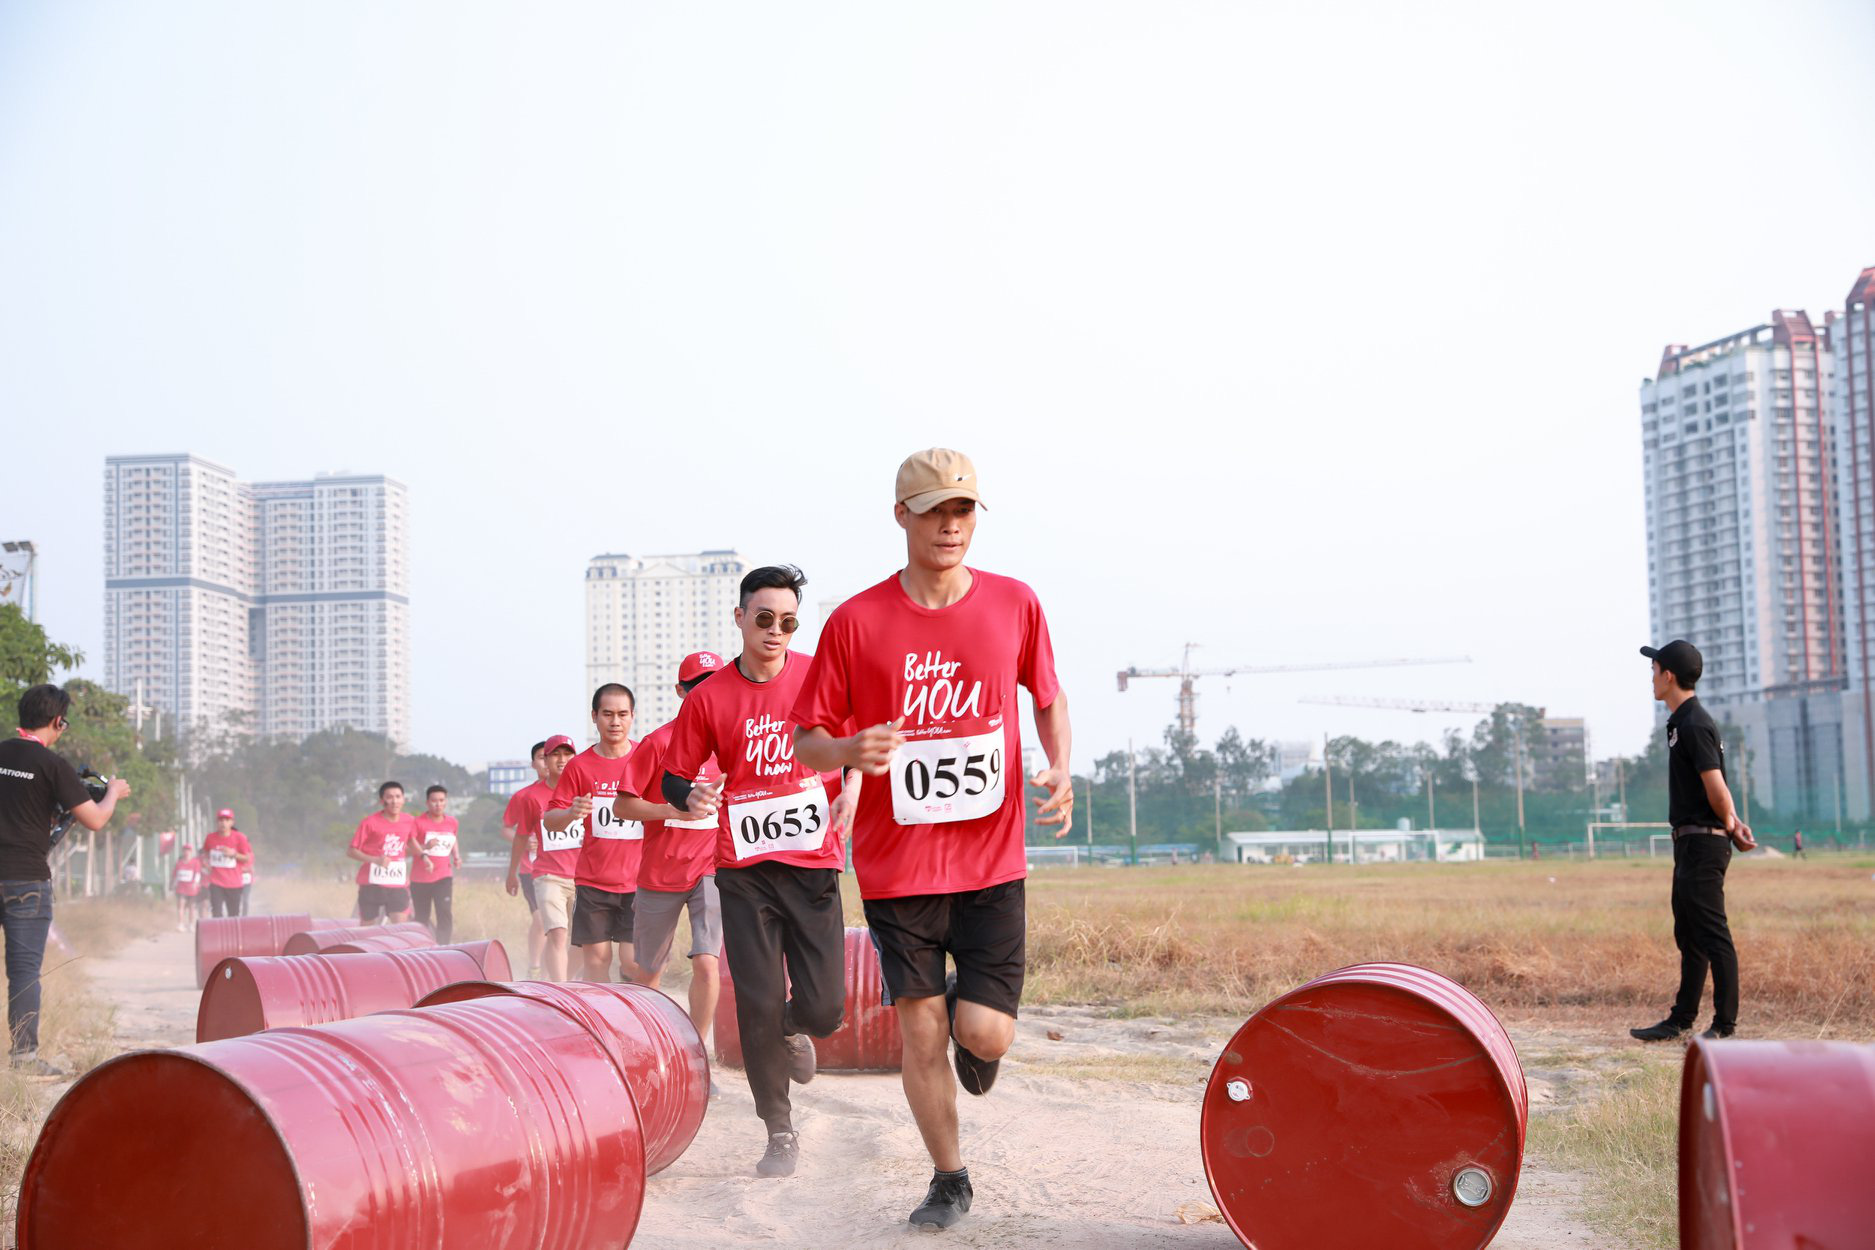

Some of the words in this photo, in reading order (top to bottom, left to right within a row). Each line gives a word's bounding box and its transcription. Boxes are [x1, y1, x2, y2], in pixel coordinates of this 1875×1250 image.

[904, 651, 961, 681] Better
[904, 679, 982, 725] YOU
[746, 714, 786, 738] Better
[905, 749, 1000, 800] 0559
[741, 804, 822, 844] 0653
